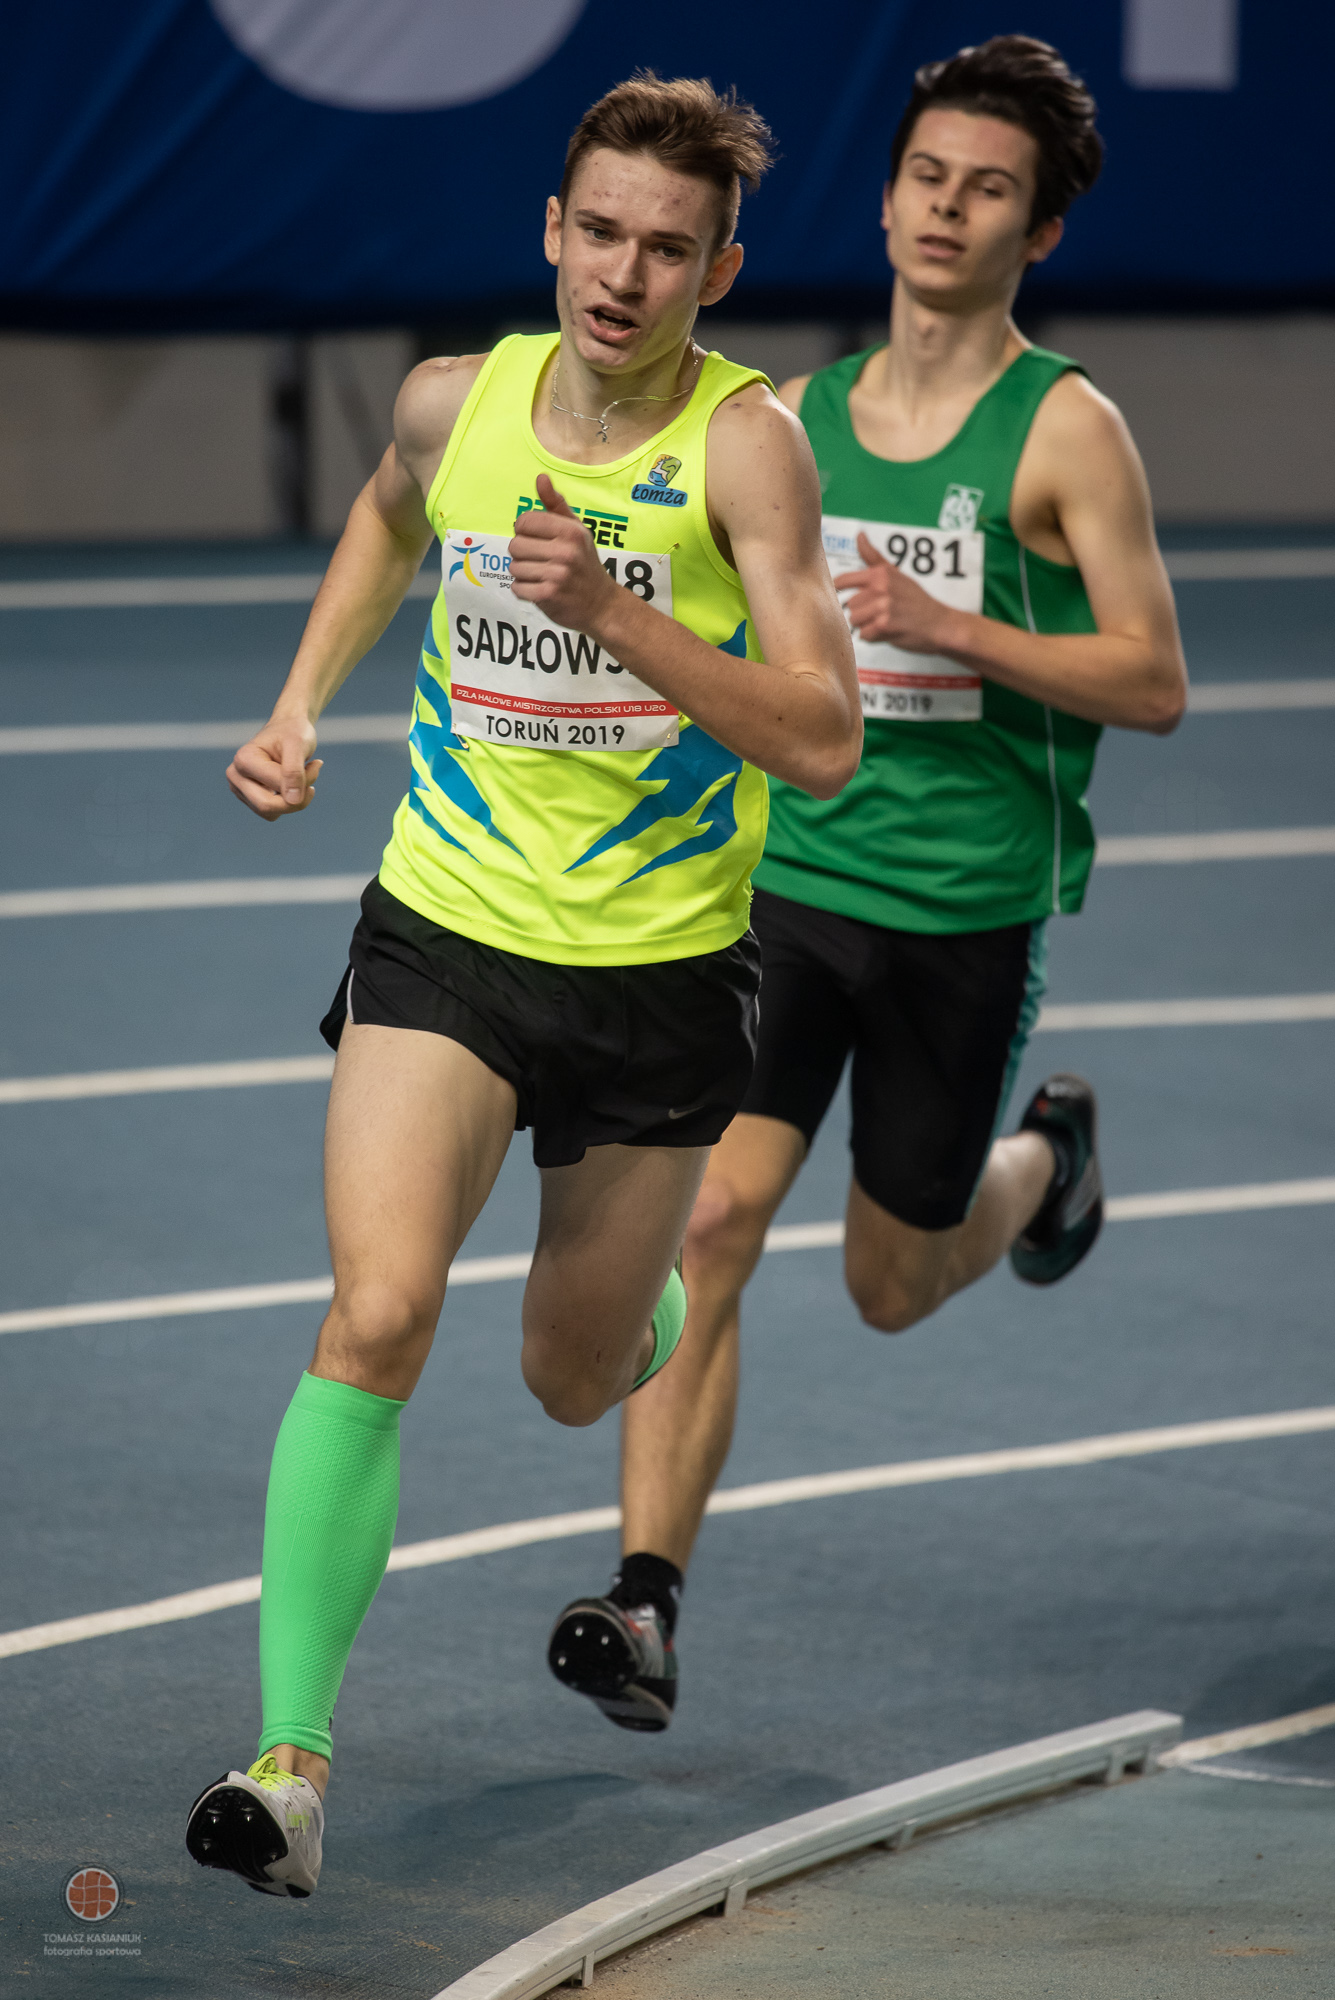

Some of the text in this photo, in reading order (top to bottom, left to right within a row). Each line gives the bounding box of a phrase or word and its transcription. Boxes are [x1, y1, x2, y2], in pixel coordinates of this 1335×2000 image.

[632, 484, 686, 506] Łomża
[480, 553, 513, 572] TOR
[887, 534, 966, 578] 981
[456, 614, 632, 675] SADŁOW
[457, 689, 667, 714] PZLA HALOWE MISTRZOSTWA POLSKI U18 U20
[486, 715, 625, 745] TORUŃ 2019
